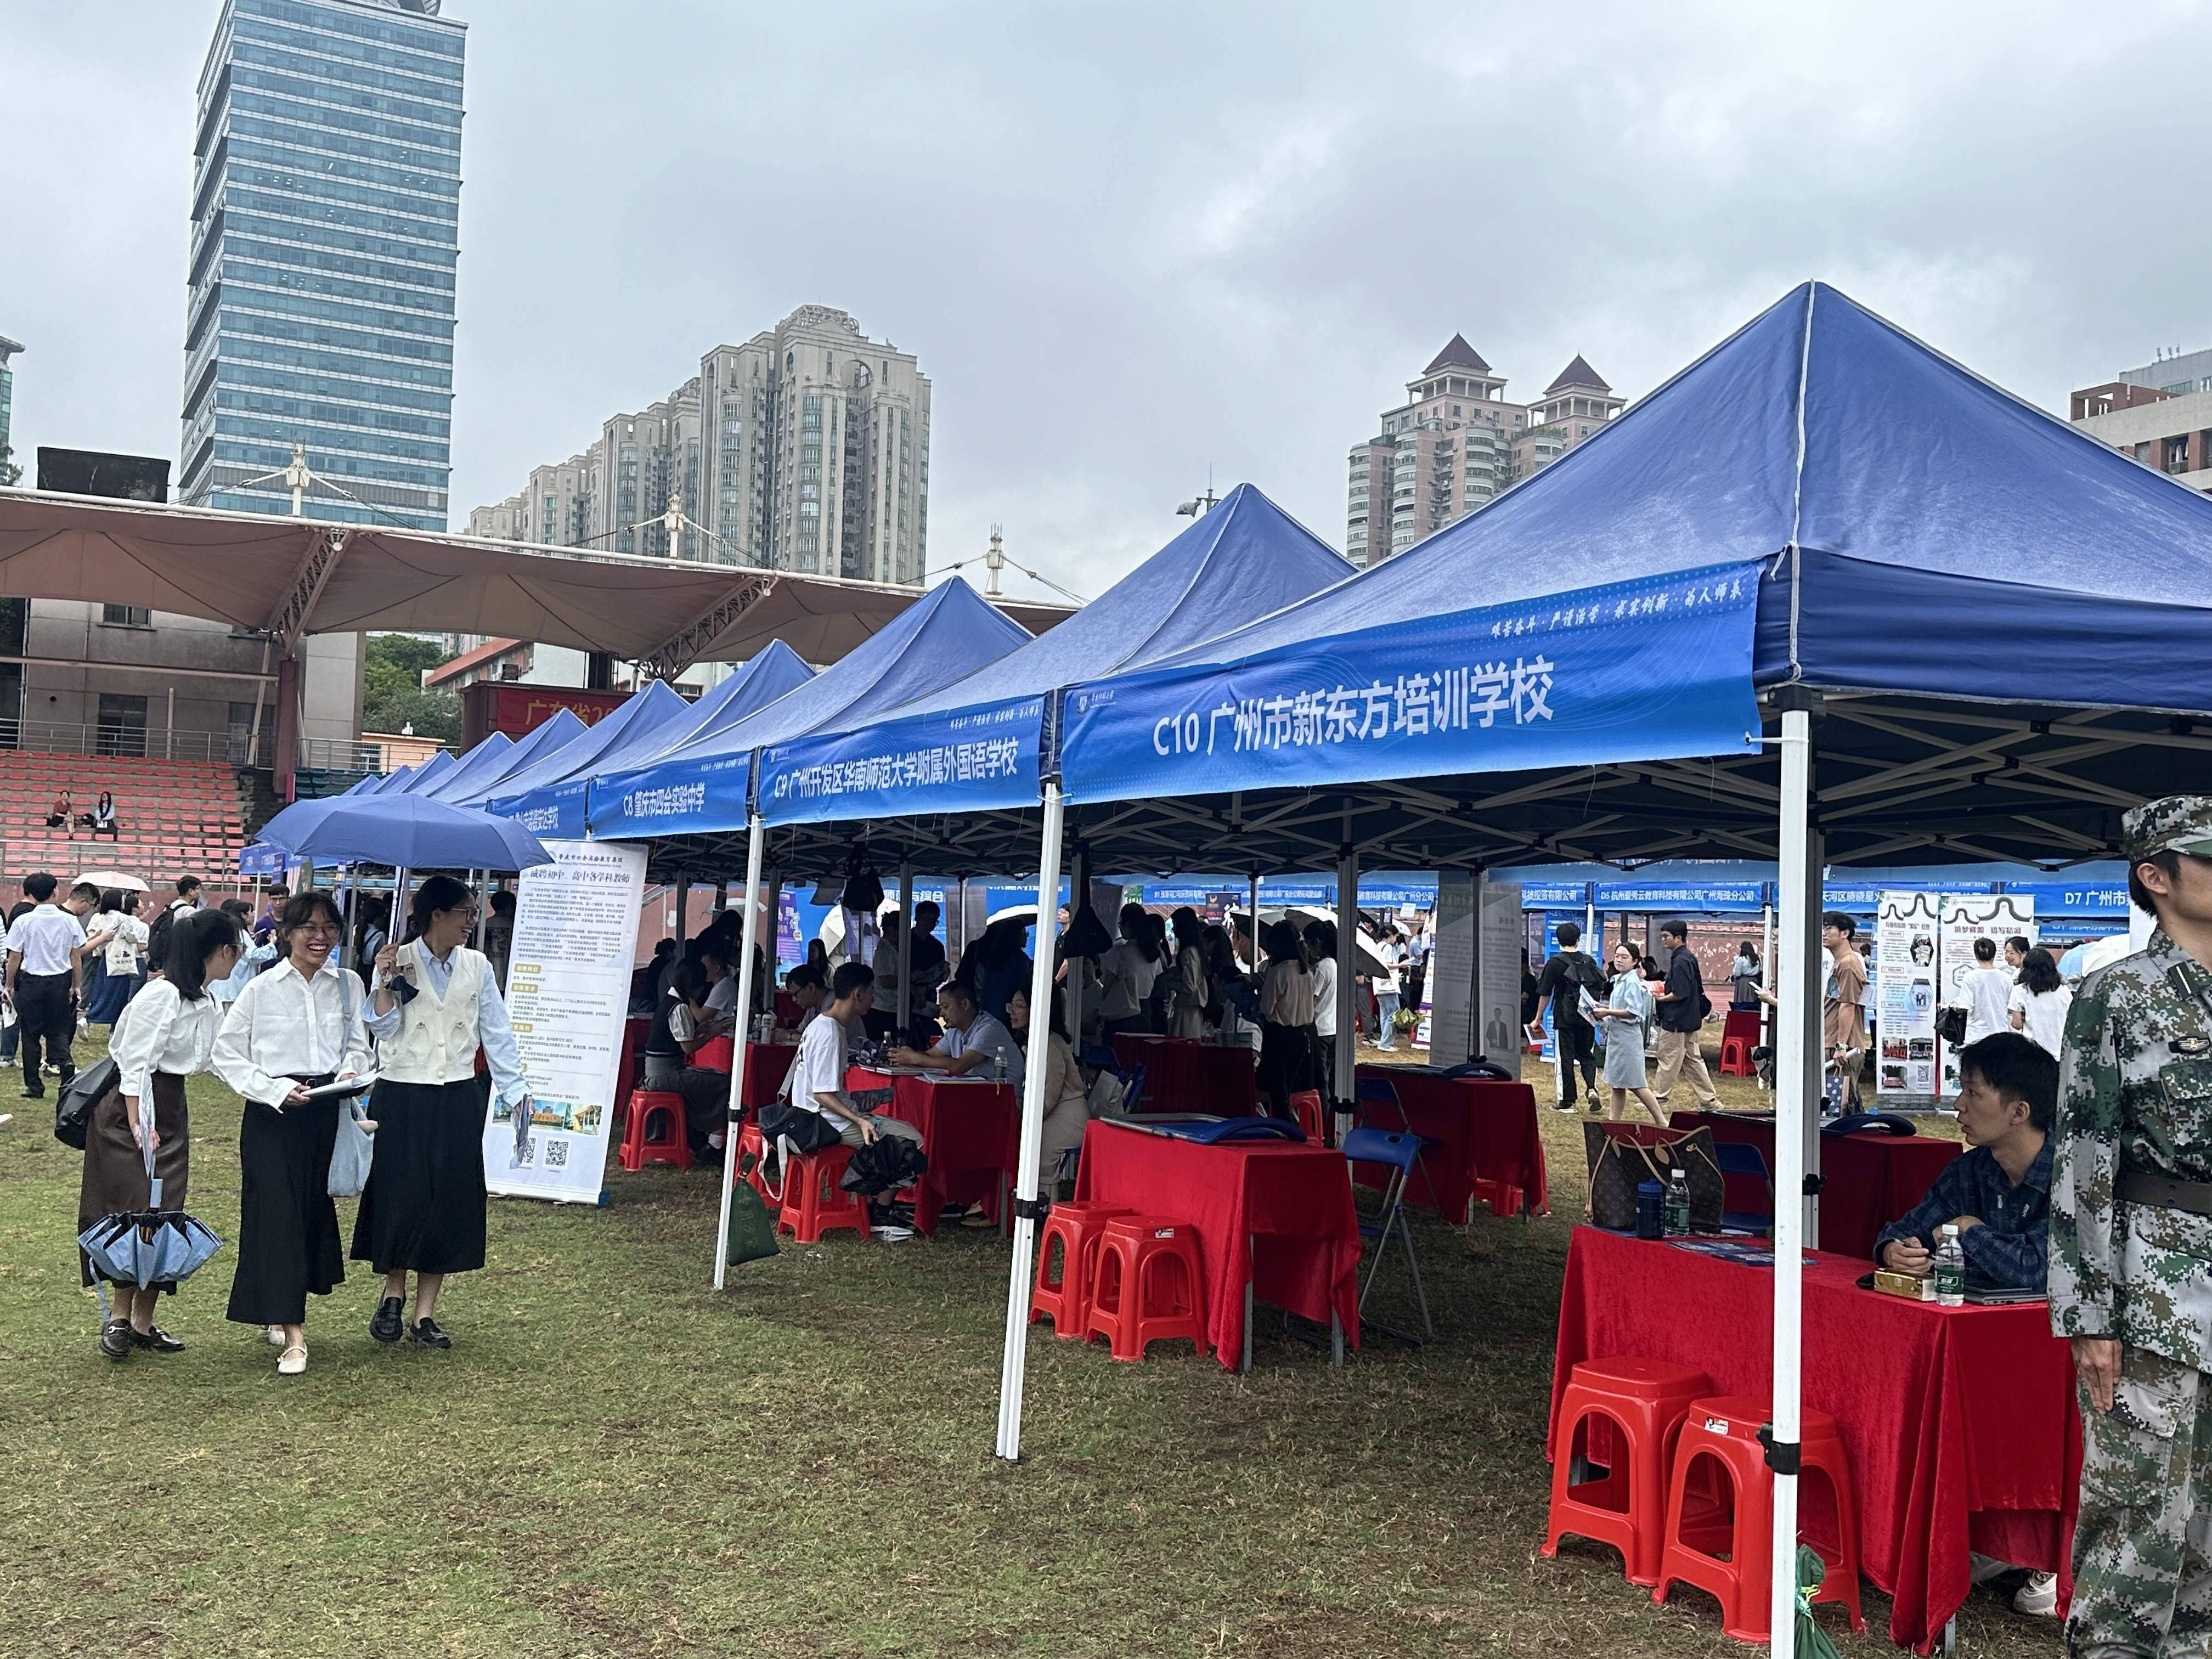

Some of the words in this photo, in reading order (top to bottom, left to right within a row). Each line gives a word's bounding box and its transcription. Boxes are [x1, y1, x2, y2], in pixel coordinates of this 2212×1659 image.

[1153, 713, 1200, 757] C10
[1206, 654, 1555, 757] 广州市新东方培训学校
[774, 774, 788, 798] C9
[789, 736, 1020, 799] 广州开发区华南师范大学附属外国语学校
[623, 795, 634, 817] C8
[634, 781, 706, 819] 肇庆市四会实验中学
[1601, 891, 1610, 900] D5
[2065, 892, 2083, 905] D7
